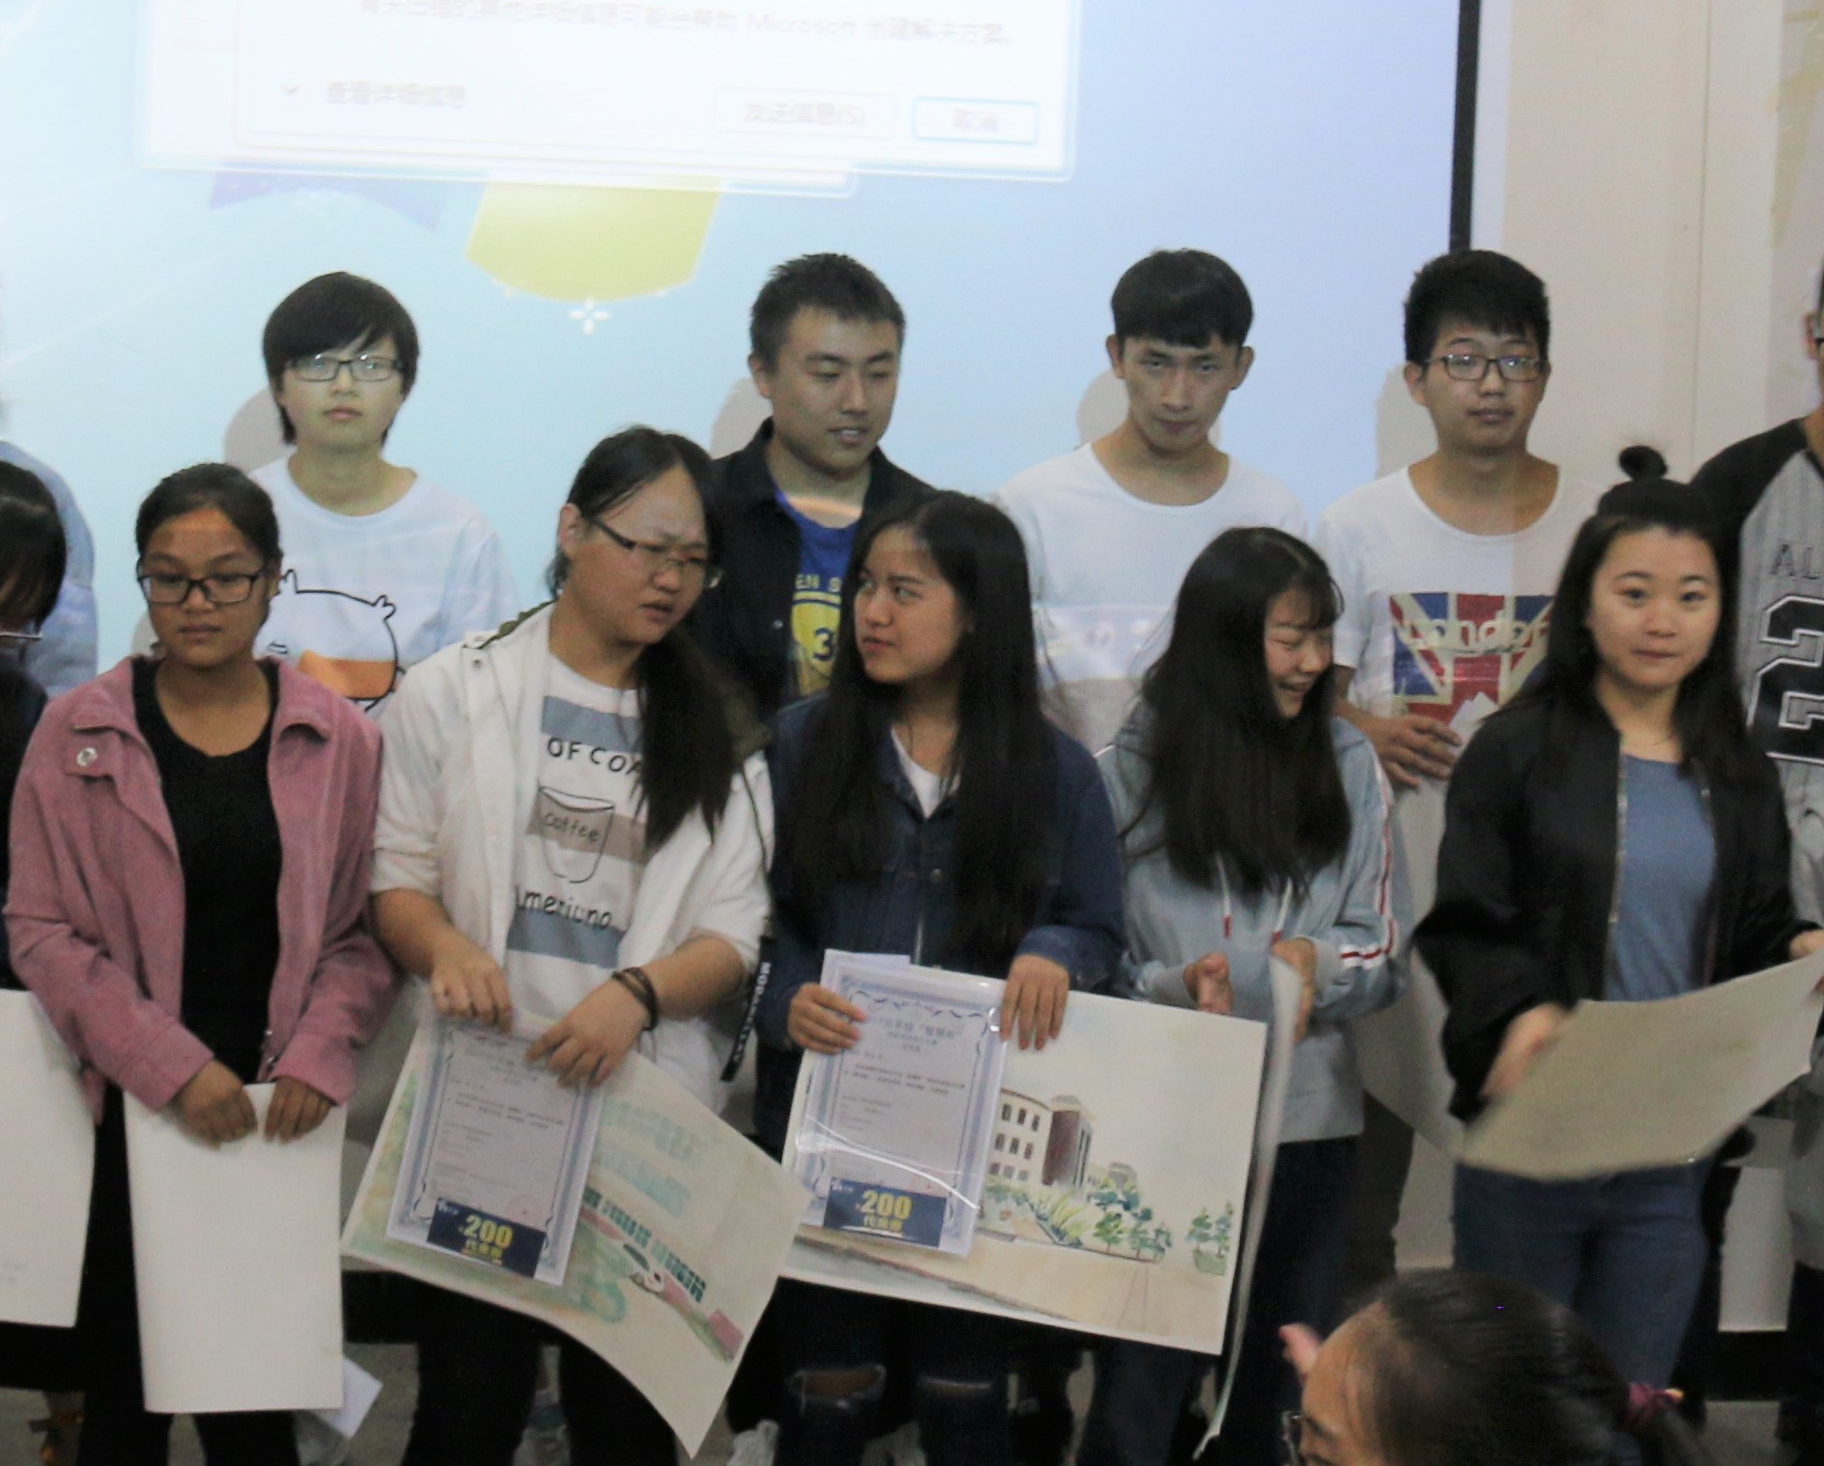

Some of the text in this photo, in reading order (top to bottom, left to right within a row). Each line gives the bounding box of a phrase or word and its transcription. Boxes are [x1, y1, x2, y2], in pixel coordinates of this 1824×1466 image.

[546, 735, 583, 761] OF
[858, 1189, 914, 1218] 200
[463, 1214, 514, 1250] 200
